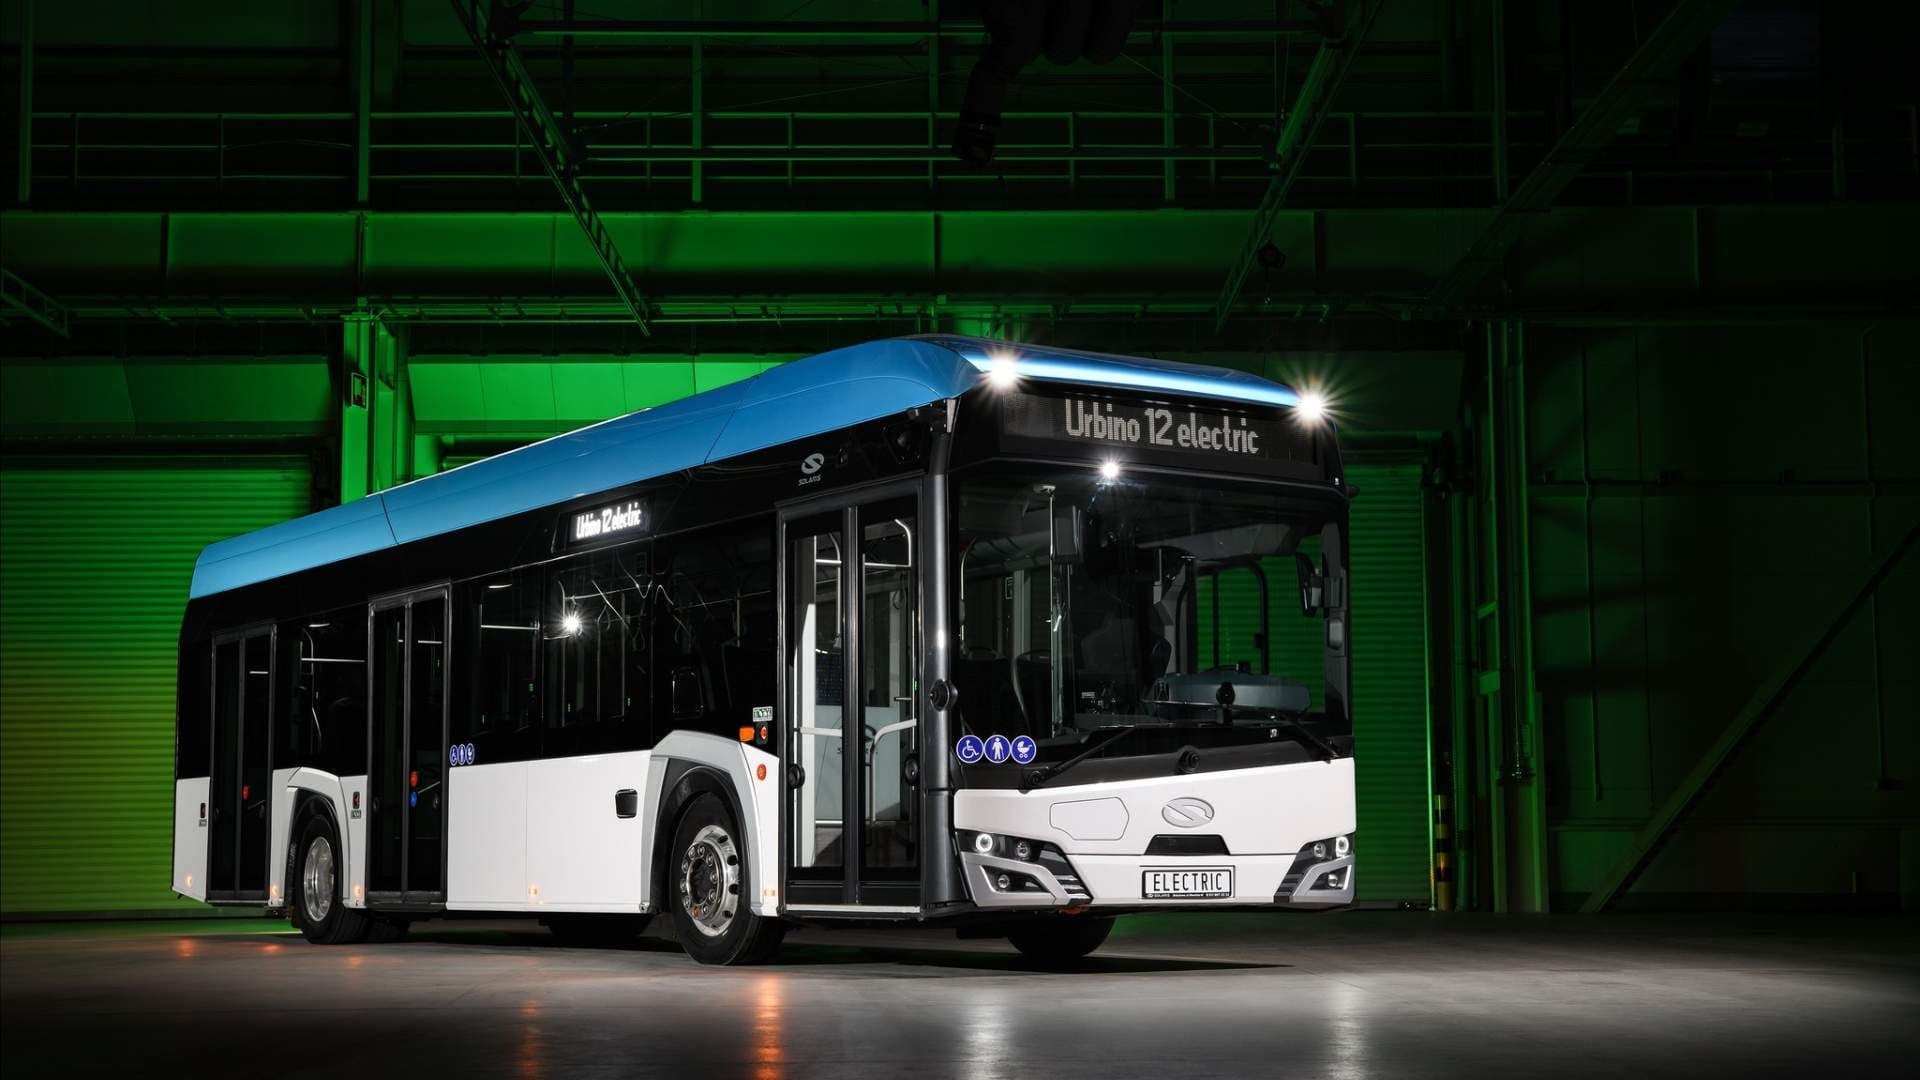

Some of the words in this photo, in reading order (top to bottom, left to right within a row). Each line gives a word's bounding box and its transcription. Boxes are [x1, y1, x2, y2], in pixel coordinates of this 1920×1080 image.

[1065, 399, 1140, 442] Urbino
[1144, 408, 1173, 446] 12
[1177, 412, 1259, 454] electric
[602, 508, 612, 533] 12
[611, 502, 641, 531] electric
[1153, 873, 1222, 891] ELECTRIC
